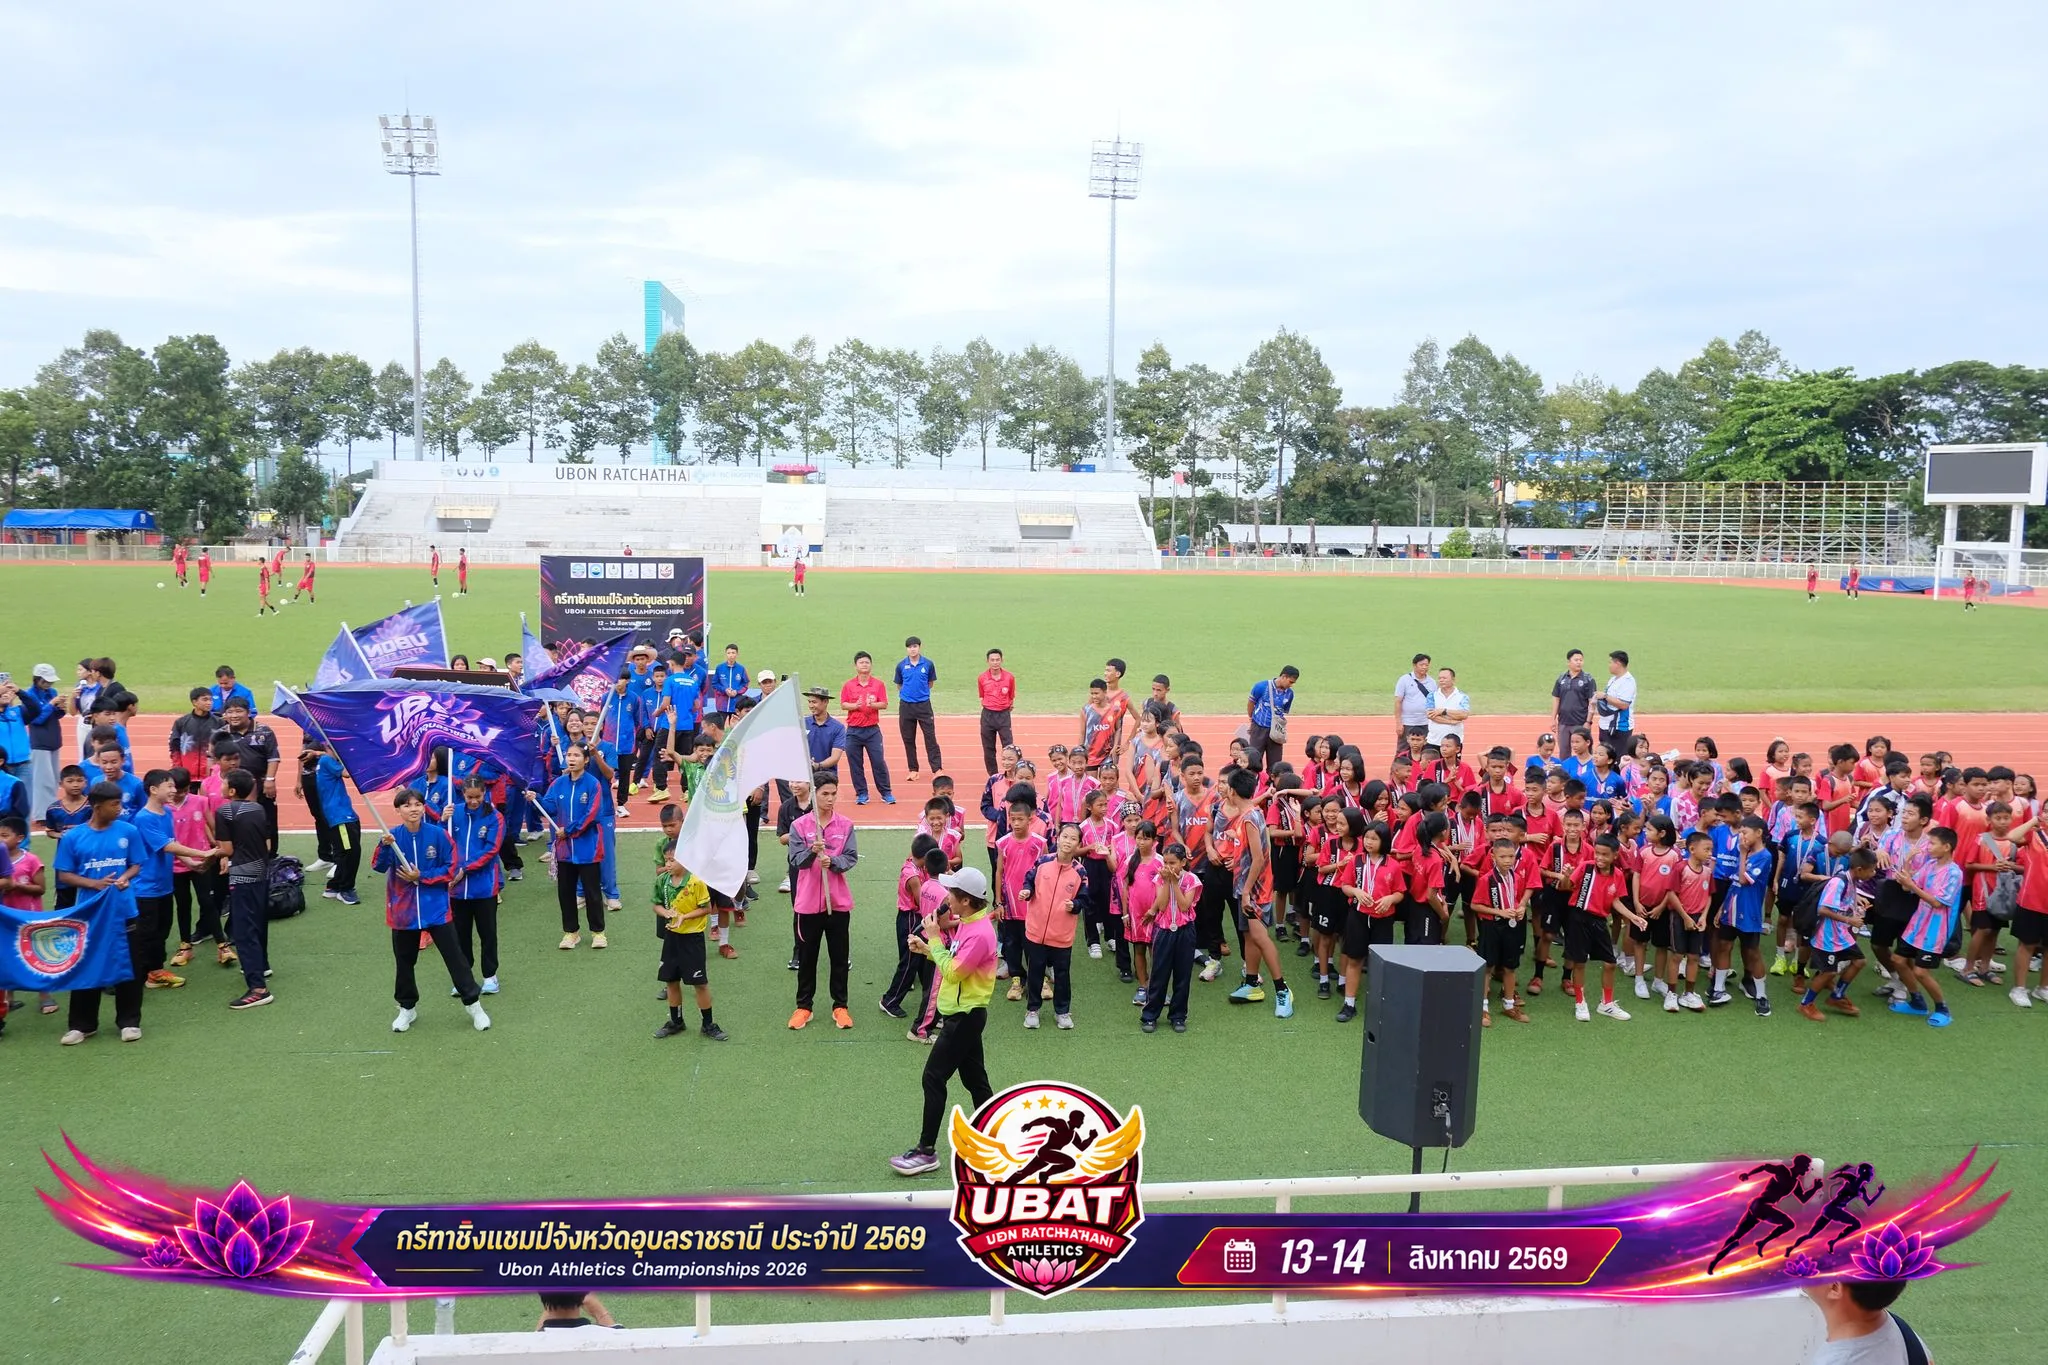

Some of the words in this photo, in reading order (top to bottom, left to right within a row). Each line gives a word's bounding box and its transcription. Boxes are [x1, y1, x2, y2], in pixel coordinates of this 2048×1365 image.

[555, 467, 597, 481] UBON
[1185, 817, 1208, 826] KNP
[1319, 914, 1329, 928] 12
[1827, 954, 1836, 965] 9
